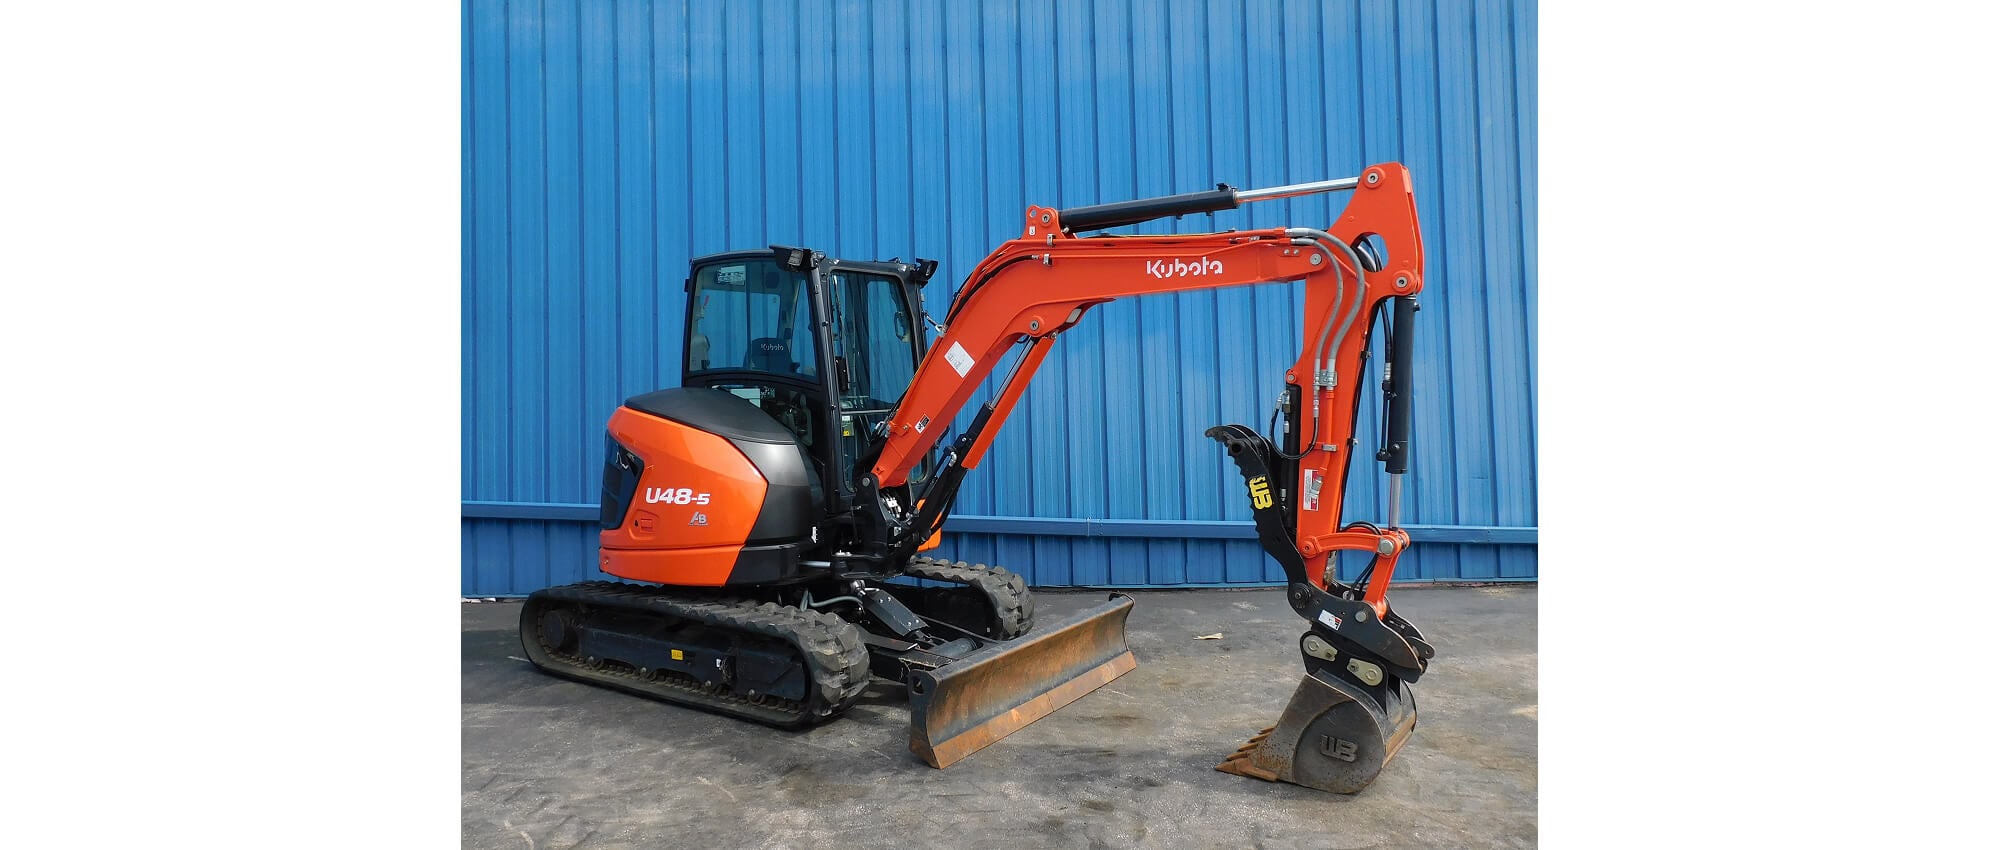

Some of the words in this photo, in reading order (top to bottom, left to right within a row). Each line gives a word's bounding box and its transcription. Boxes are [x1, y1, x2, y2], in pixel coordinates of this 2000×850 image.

[1146, 256, 1223, 279] Kubota
[760, 343, 784, 351] Kubota
[645, 487, 711, 505] U48-5
